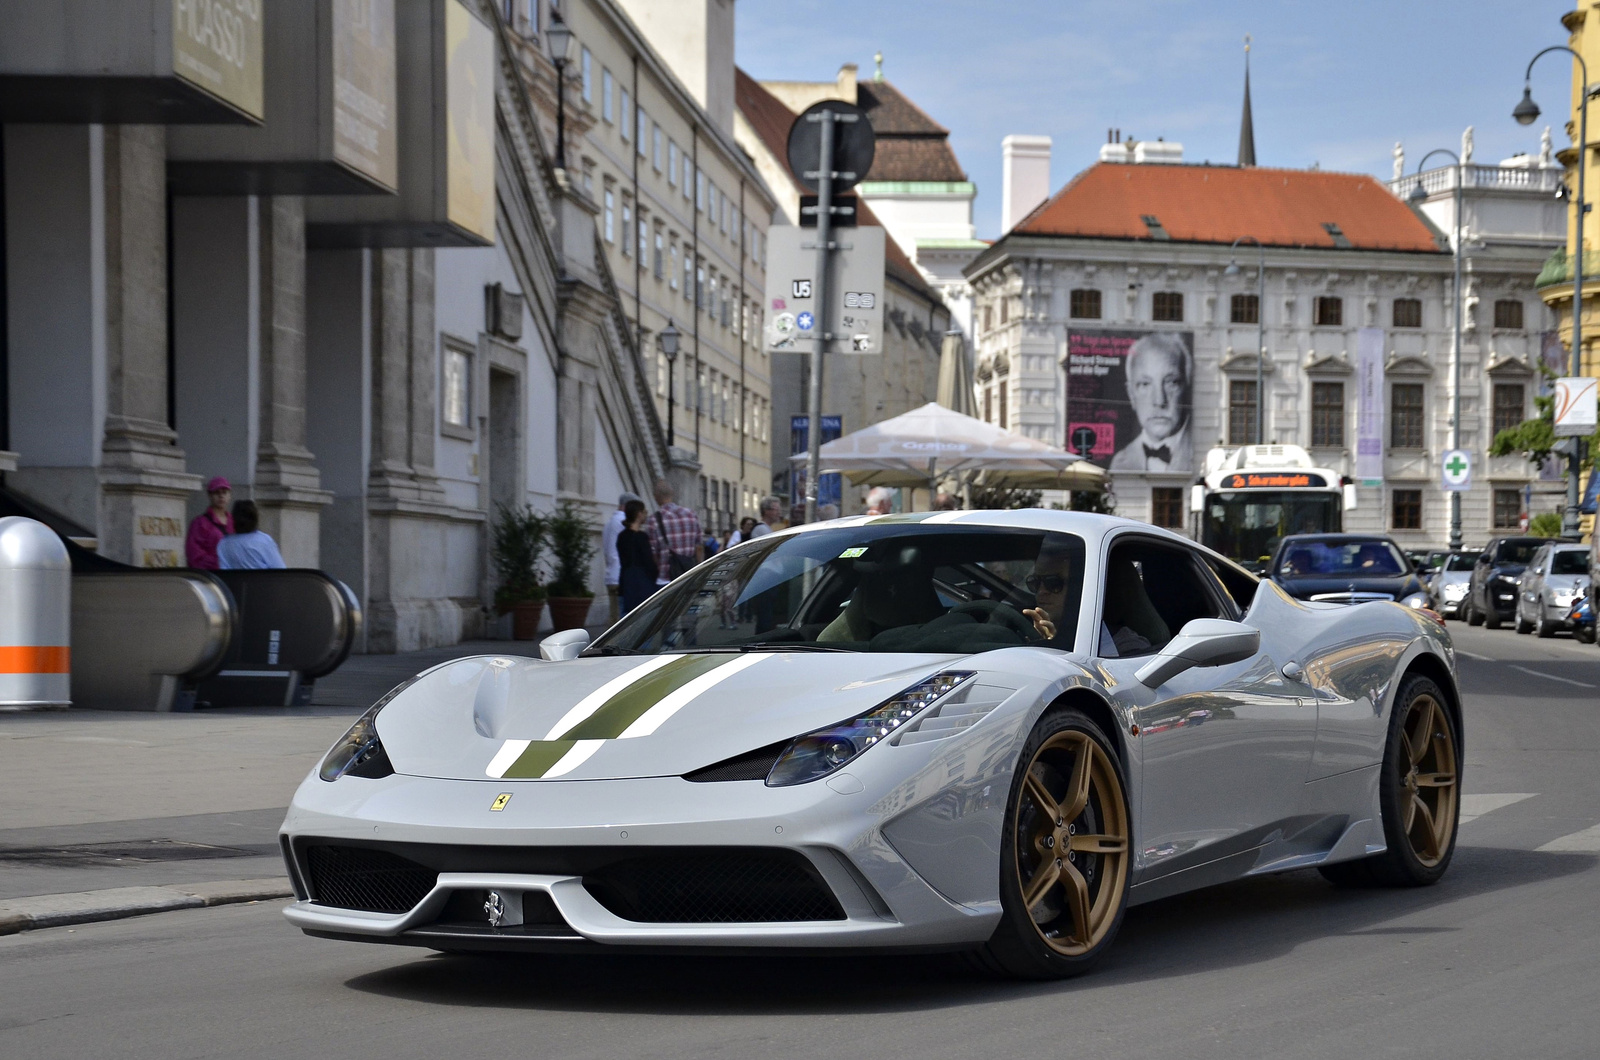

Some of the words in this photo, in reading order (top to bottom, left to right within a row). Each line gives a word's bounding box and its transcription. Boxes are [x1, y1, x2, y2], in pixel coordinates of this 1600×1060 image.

[177, 0, 245, 68] PICASSO
[793, 281, 810, 297] U5
[1070, 355, 1095, 365] Richard
[1095, 355, 1120, 366] Strauss
